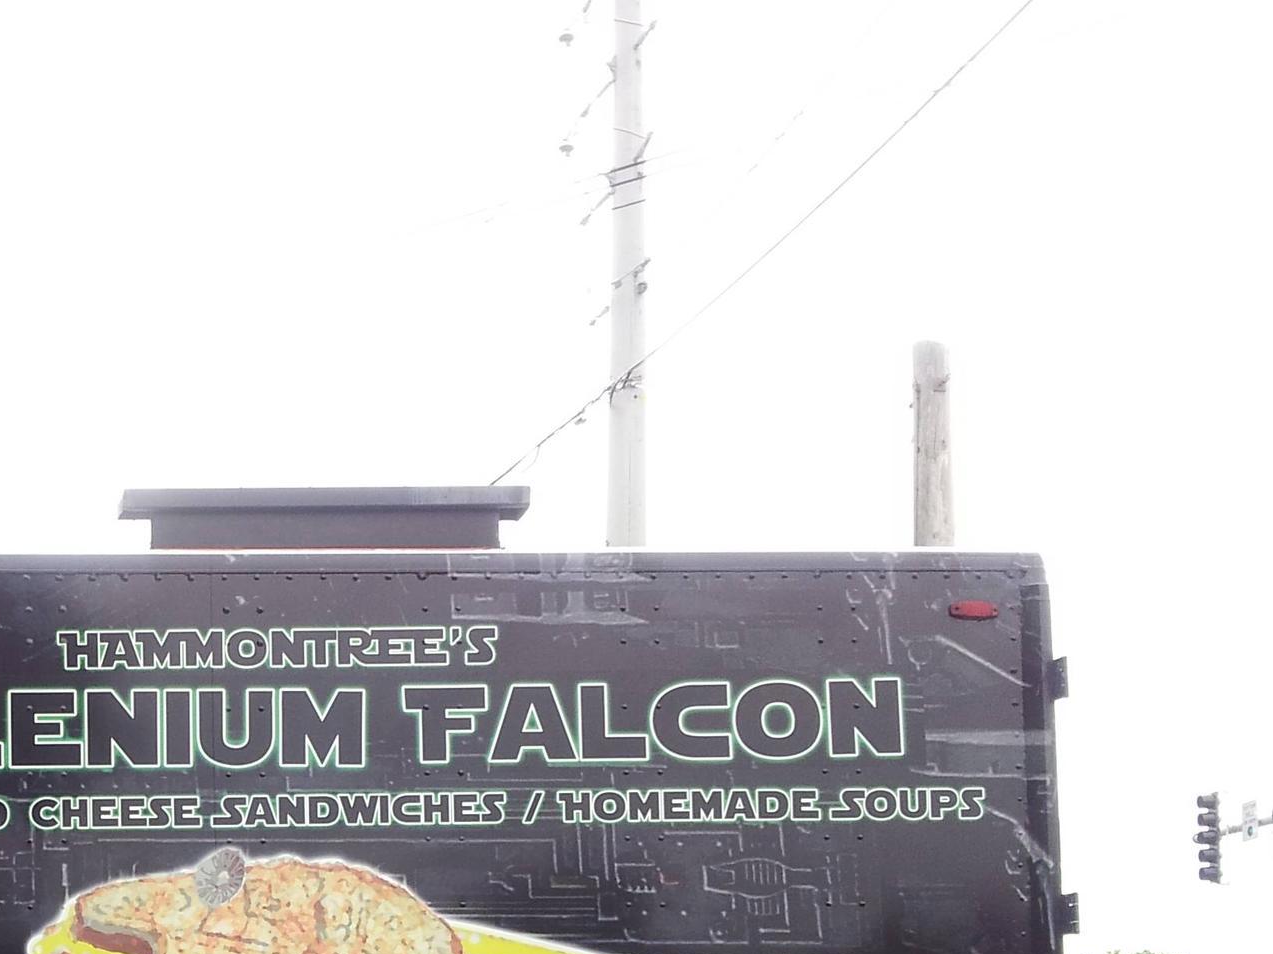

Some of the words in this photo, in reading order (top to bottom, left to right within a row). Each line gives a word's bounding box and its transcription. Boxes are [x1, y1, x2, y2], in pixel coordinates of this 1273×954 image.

[56, 624, 499, 670] HAMMONTREE'S
[401, 676, 905, 764] FALCON
[29, 794, 203, 830] CHEESE
[210, 791, 507, 828] SANDWICHES
[556, 787, 822, 823] HOMEMADE
[829, 786, 985, 821] SOUPS
